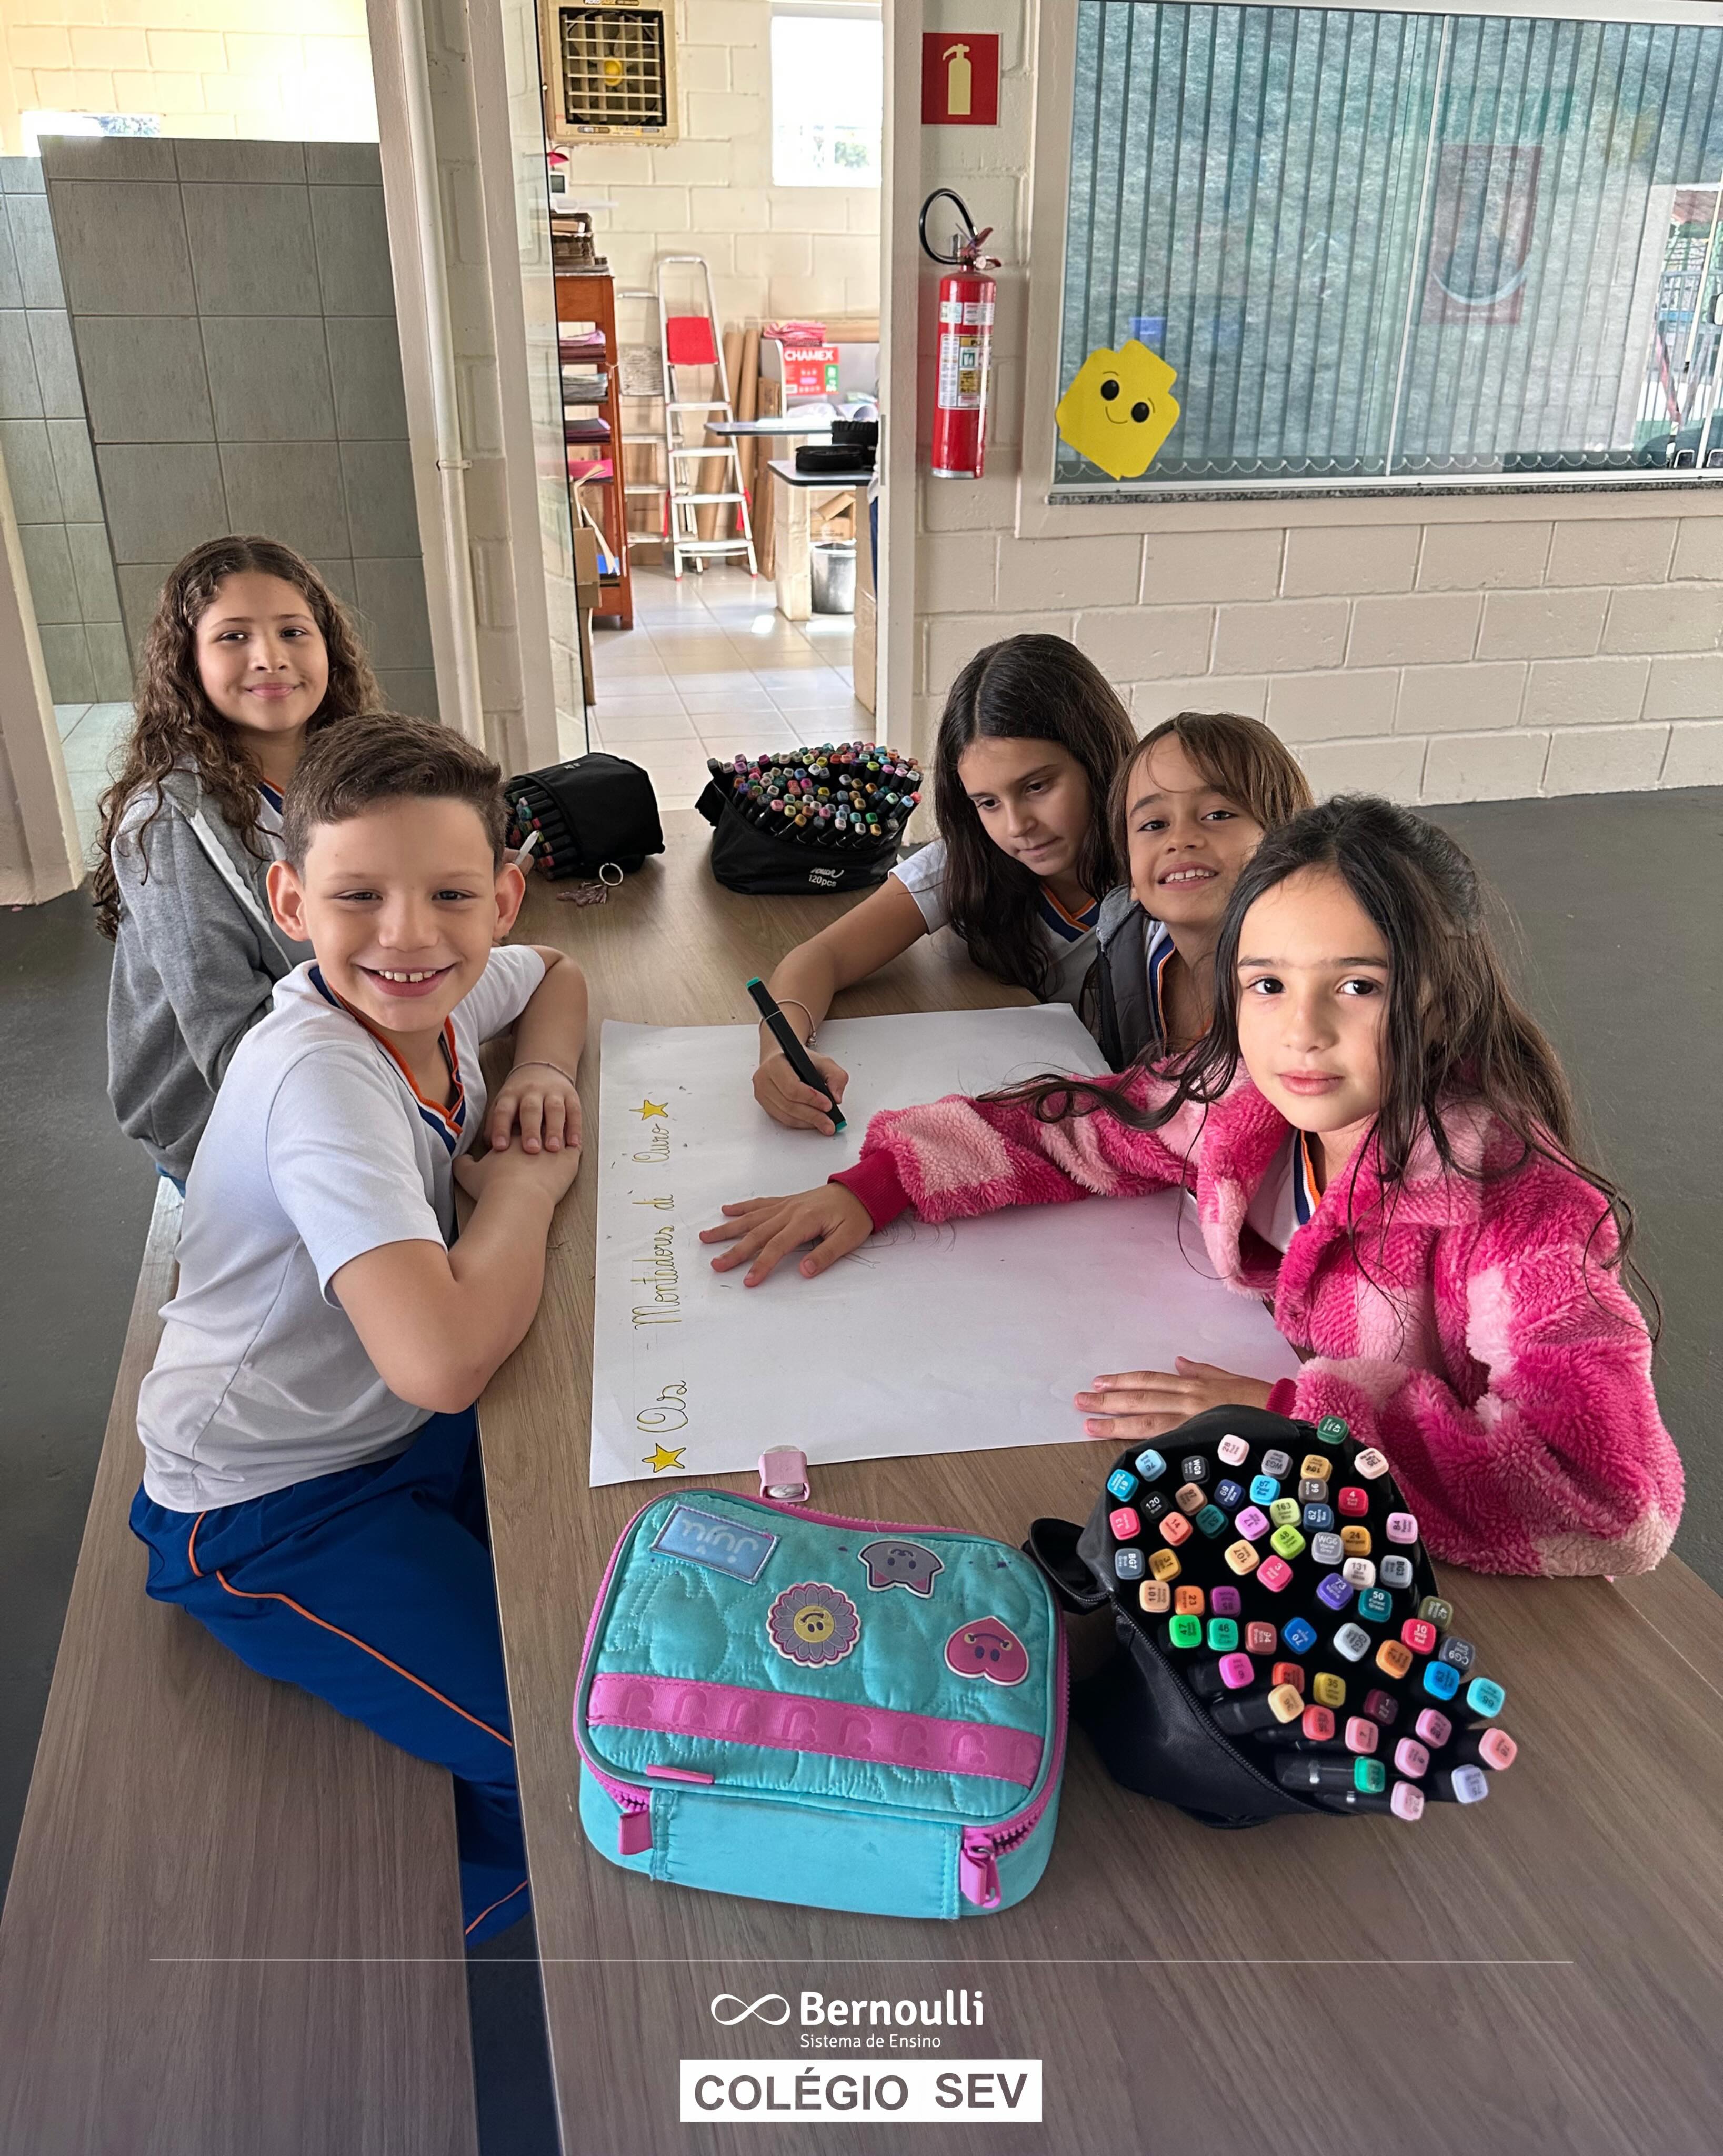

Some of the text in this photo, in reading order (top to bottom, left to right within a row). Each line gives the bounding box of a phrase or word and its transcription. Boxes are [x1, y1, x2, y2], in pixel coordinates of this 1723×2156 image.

[784, 350, 834, 361] CHAMEX
[809, 875, 837, 887] 120pcs
[630, 1225, 682, 1330] Montadores
[1332, 1424, 1341, 1433] 43
[1222, 1442, 1231, 1452] 28
[1193, 1459, 1201, 1475] WG9
[1265, 1460, 1283, 1470] WG3
[1120, 1480, 1128, 1490] 61
[1219, 1485, 1229, 1496] 69
[1146, 1496, 1160, 1510] 120
[1276, 1502, 1291, 1511] 163
[1308, 1510, 1316, 1520] 62
[1115, 1518, 1124, 1528] 13
[1171, 1519, 1180, 1528] 14
[1244, 1518, 1254, 1527] 17
[1393, 1521, 1400, 1530] 84
[1280, 1531, 1289, 1539] 48
[1318, 1535, 1338, 1545] WG6
[1128, 1553, 1137, 1569] BG7
[1163, 1556, 1173, 1567] 31
[1234, 1550, 1247, 1563] 107
[1351, 1562, 1366, 1571] 131
[1396, 1561, 1405, 1575] BG3
[1335, 1578, 1347, 1590] 73
[1188, 1595, 1196, 1606] 23
[1373, 1591, 1384, 1600] 50
[1438, 1608, 1447, 1619] 42
[1179, 1623, 1187, 1635] 47
[1416, 1624, 1427, 1633] 10
[1264, 1631, 1271, 1643] 94
[1292, 1634, 1304, 1645] 70
[1449, 1650, 1469, 1665] CG9
[1328, 1678, 1338, 1688] 35
